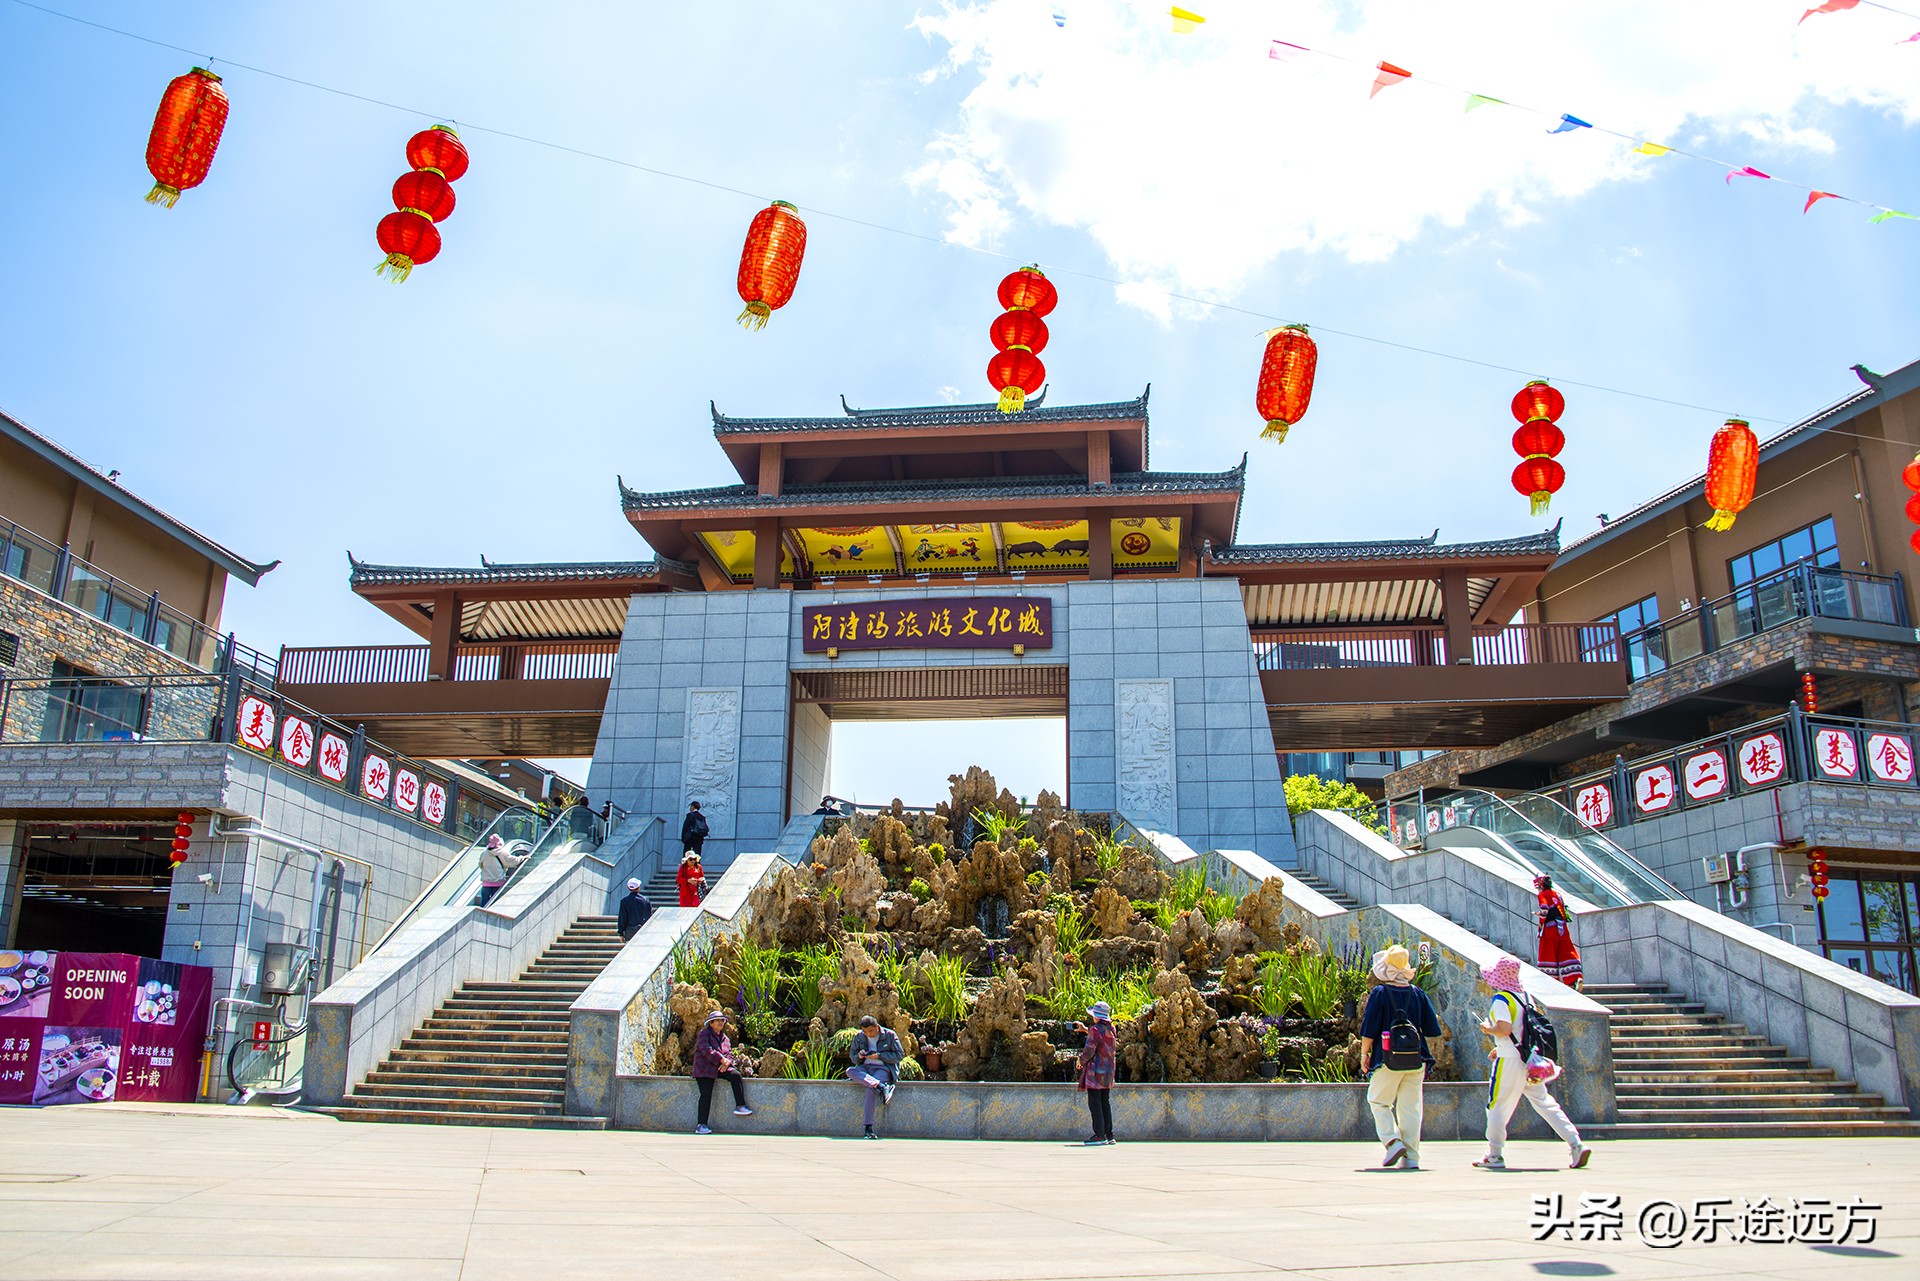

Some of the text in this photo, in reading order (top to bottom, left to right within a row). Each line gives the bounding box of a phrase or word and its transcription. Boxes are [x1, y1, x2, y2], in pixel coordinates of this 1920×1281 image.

[811, 603, 1044, 641] 阿诗玛旅游文化城
[245, 703, 443, 819] 美食城欢迎您
[1824, 733, 1910, 777] 美食
[1581, 740, 1777, 824] 请上二楼
[66, 969, 127, 984] OPENING
[64, 988, 105, 1000] SOON
[1, 1038, 30, 1051] 原汤
[0, 1052, 28, 1061] 大筒骨
[1, 1070, 25, 1082] 小时
[122, 1069, 161, 1087] 三十载
